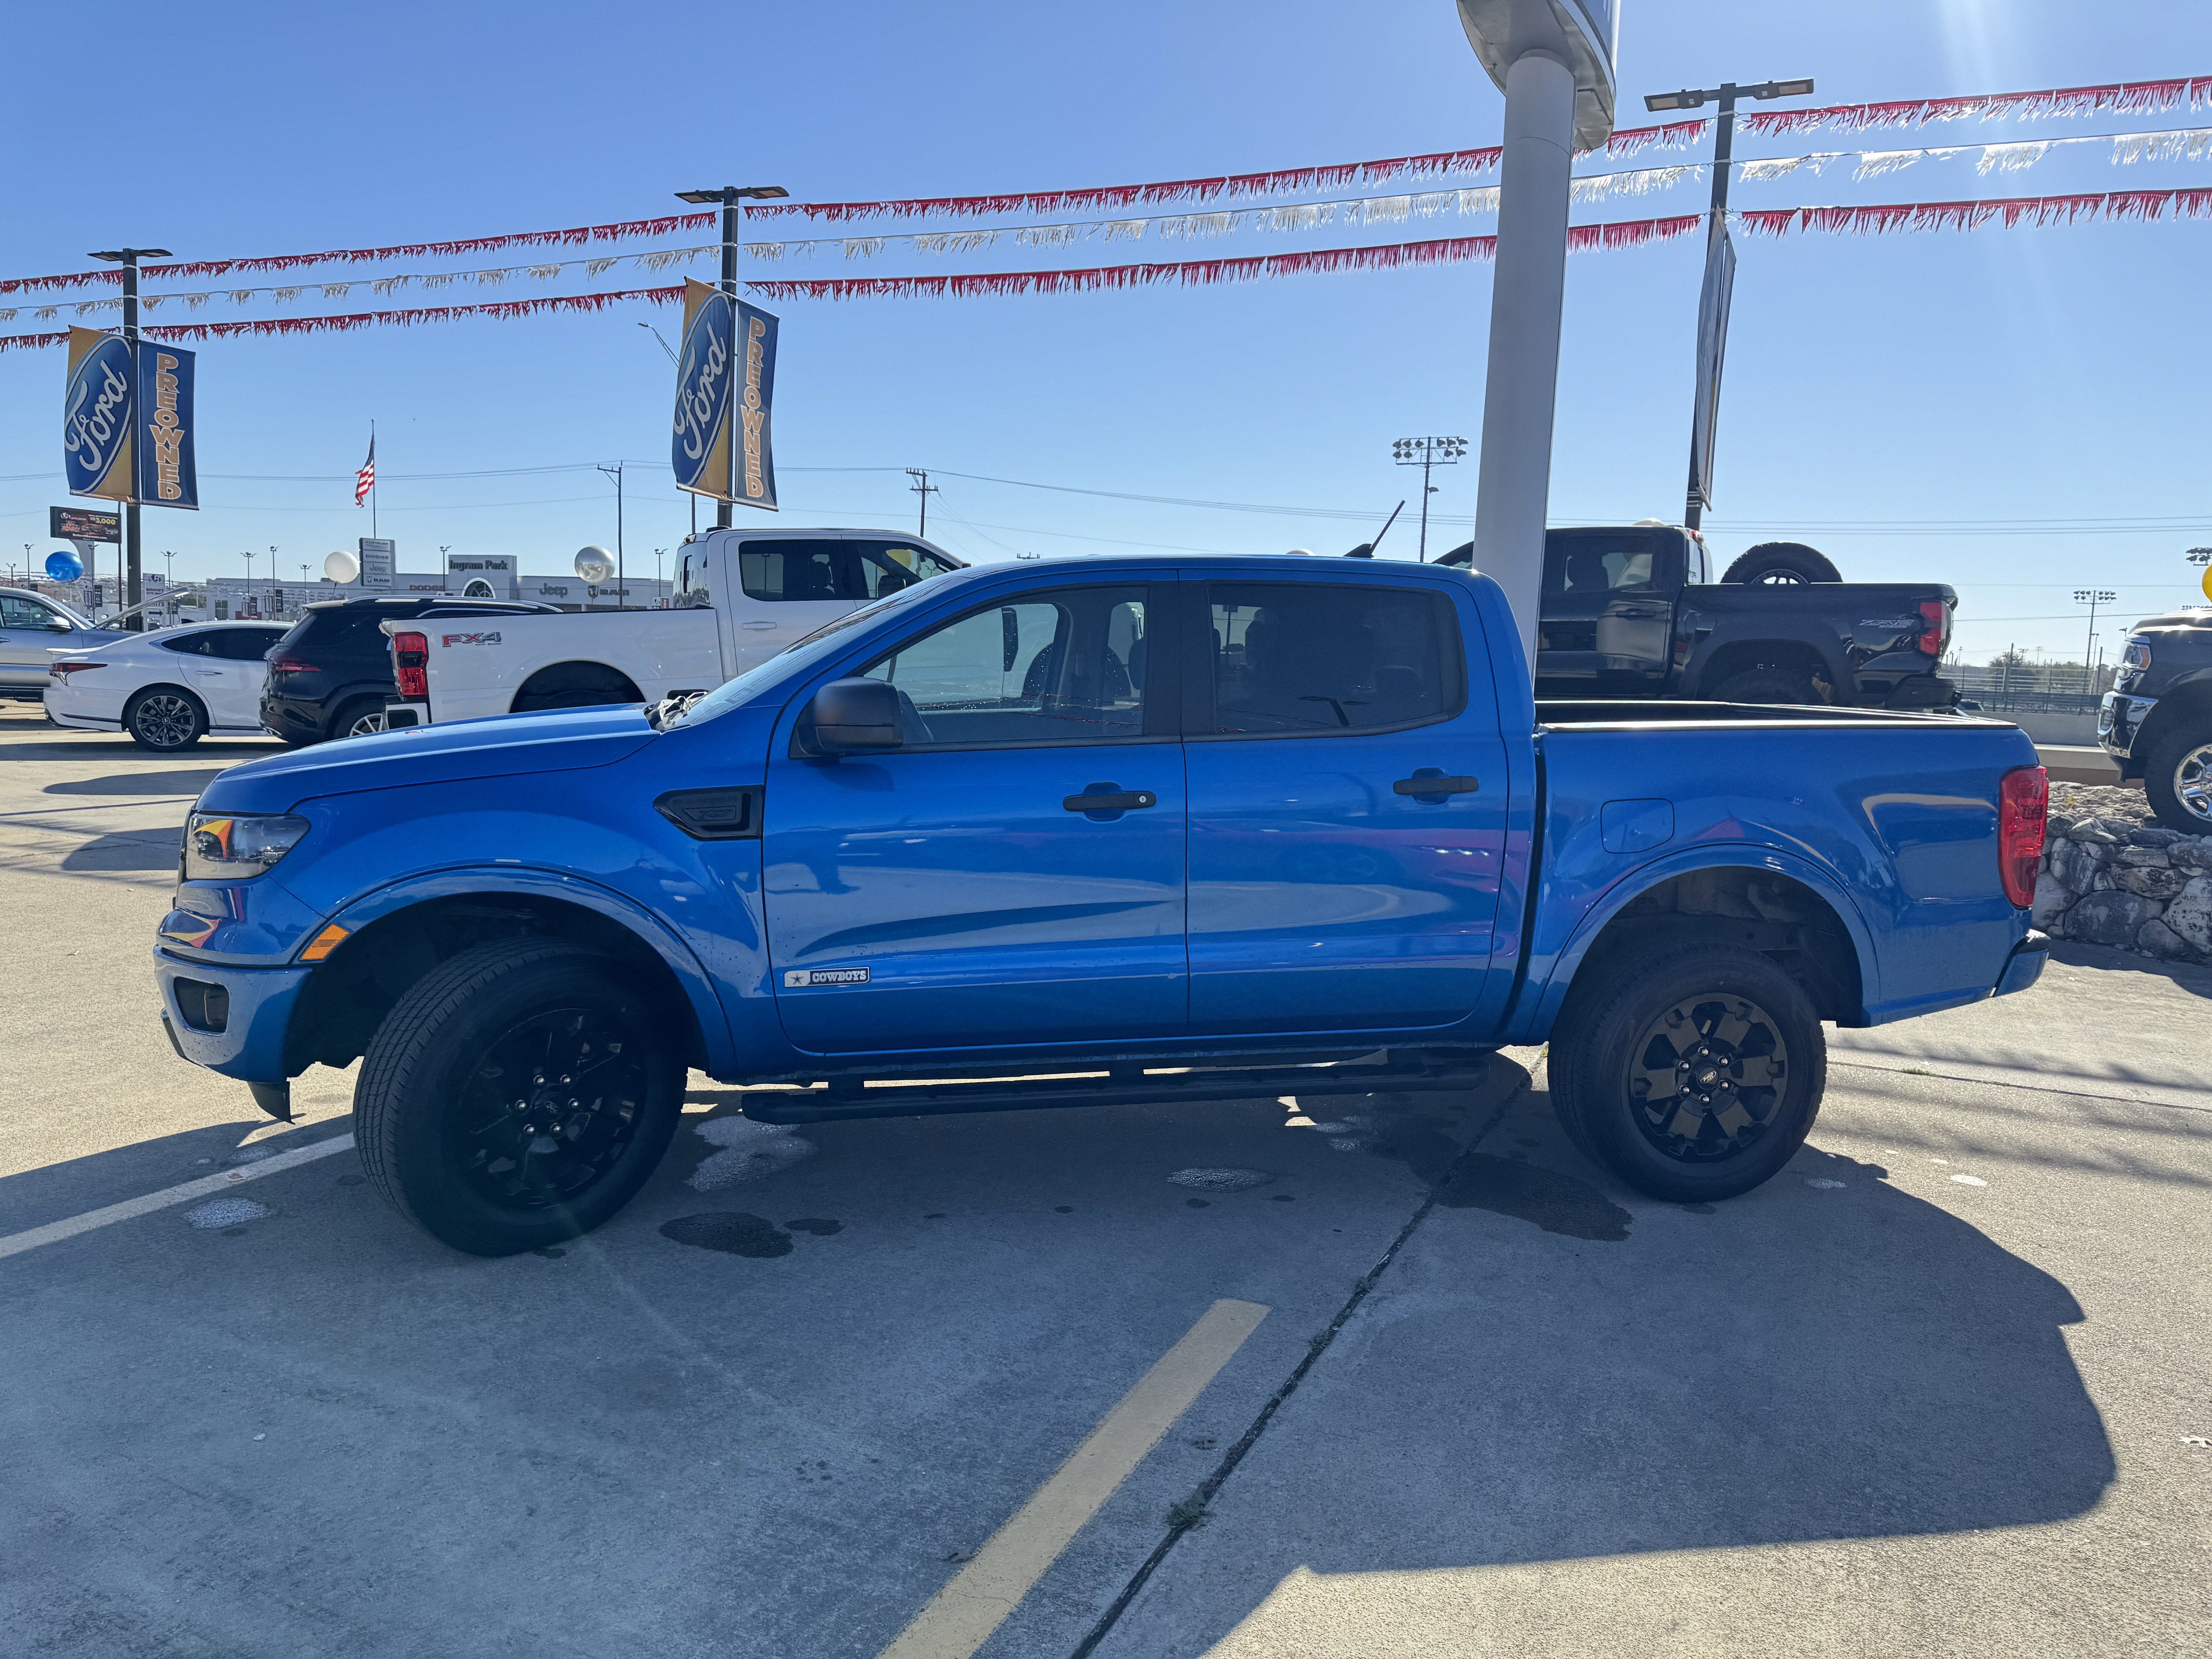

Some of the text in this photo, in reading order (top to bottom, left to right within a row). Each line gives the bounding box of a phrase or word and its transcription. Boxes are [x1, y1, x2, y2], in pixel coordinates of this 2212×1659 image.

[674, 321, 726, 459] Ford
[740, 316, 766, 498] PREOWNED
[65, 360, 127, 471] Ford
[149, 352, 185, 500] PREOWNED
[369, 564, 386, 572] Jeep
[449, 560, 508, 571] Ingram Park
[539, 582, 568, 598] Jeep
[441, 632, 501, 647] FX4
[812, 970, 867, 982] COWBOYS
